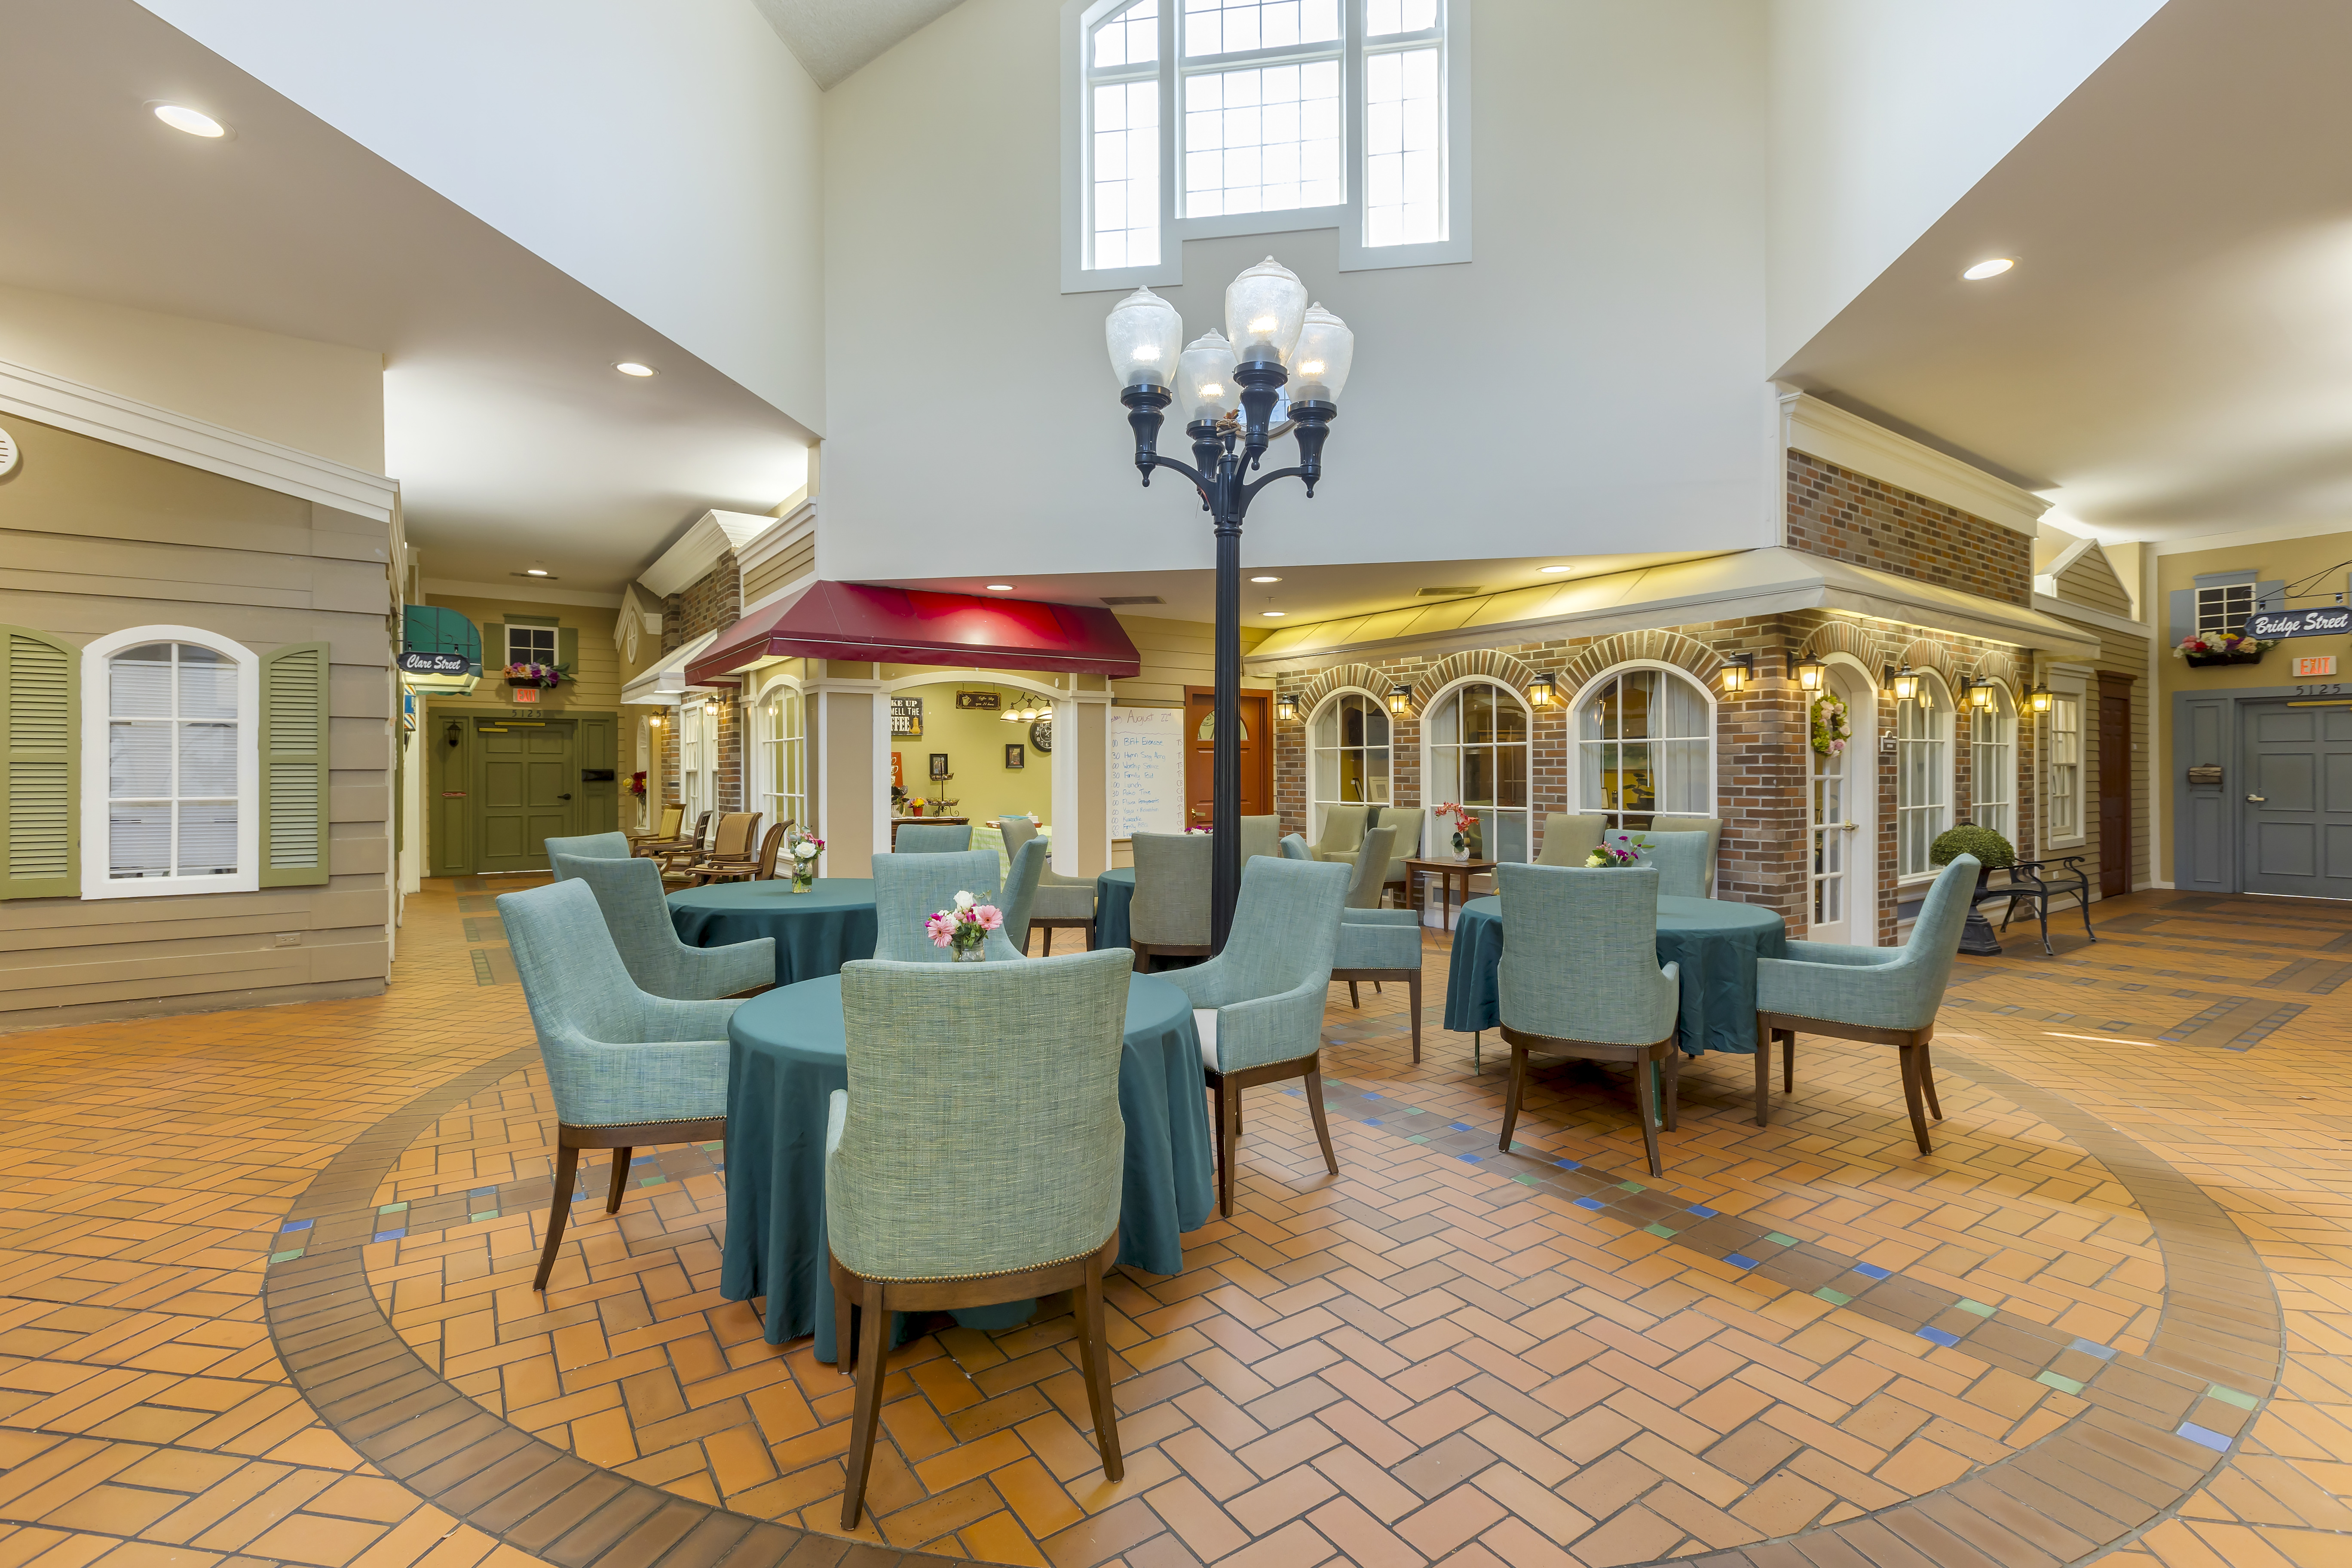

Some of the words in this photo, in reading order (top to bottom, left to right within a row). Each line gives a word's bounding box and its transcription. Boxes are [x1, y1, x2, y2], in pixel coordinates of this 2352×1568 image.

[2255, 617, 2301, 637] Bridge
[2303, 612, 2349, 631] Street
[407, 654, 432, 669] Clare
[433, 656, 461, 670] Street
[2301, 657, 2330, 675] EXIT
[518, 689, 536, 702] EXIT
[2296, 684, 2341, 696] 5125
[891, 707, 905, 716] MELL
[907, 707, 920, 716] THE
[1127, 709, 1154, 726] August
[1161, 712, 1172, 722] 22nd
[891, 716, 910, 731] FFEE
[1124, 751, 1139, 761] Hymn
[1140, 751, 1153, 762] Sing
[1123, 762, 1141, 771] Worship
[1124, 771, 1141, 781] Family
[1176, 770, 1184, 778] TS
[1123, 807, 1135, 815] Yoga
